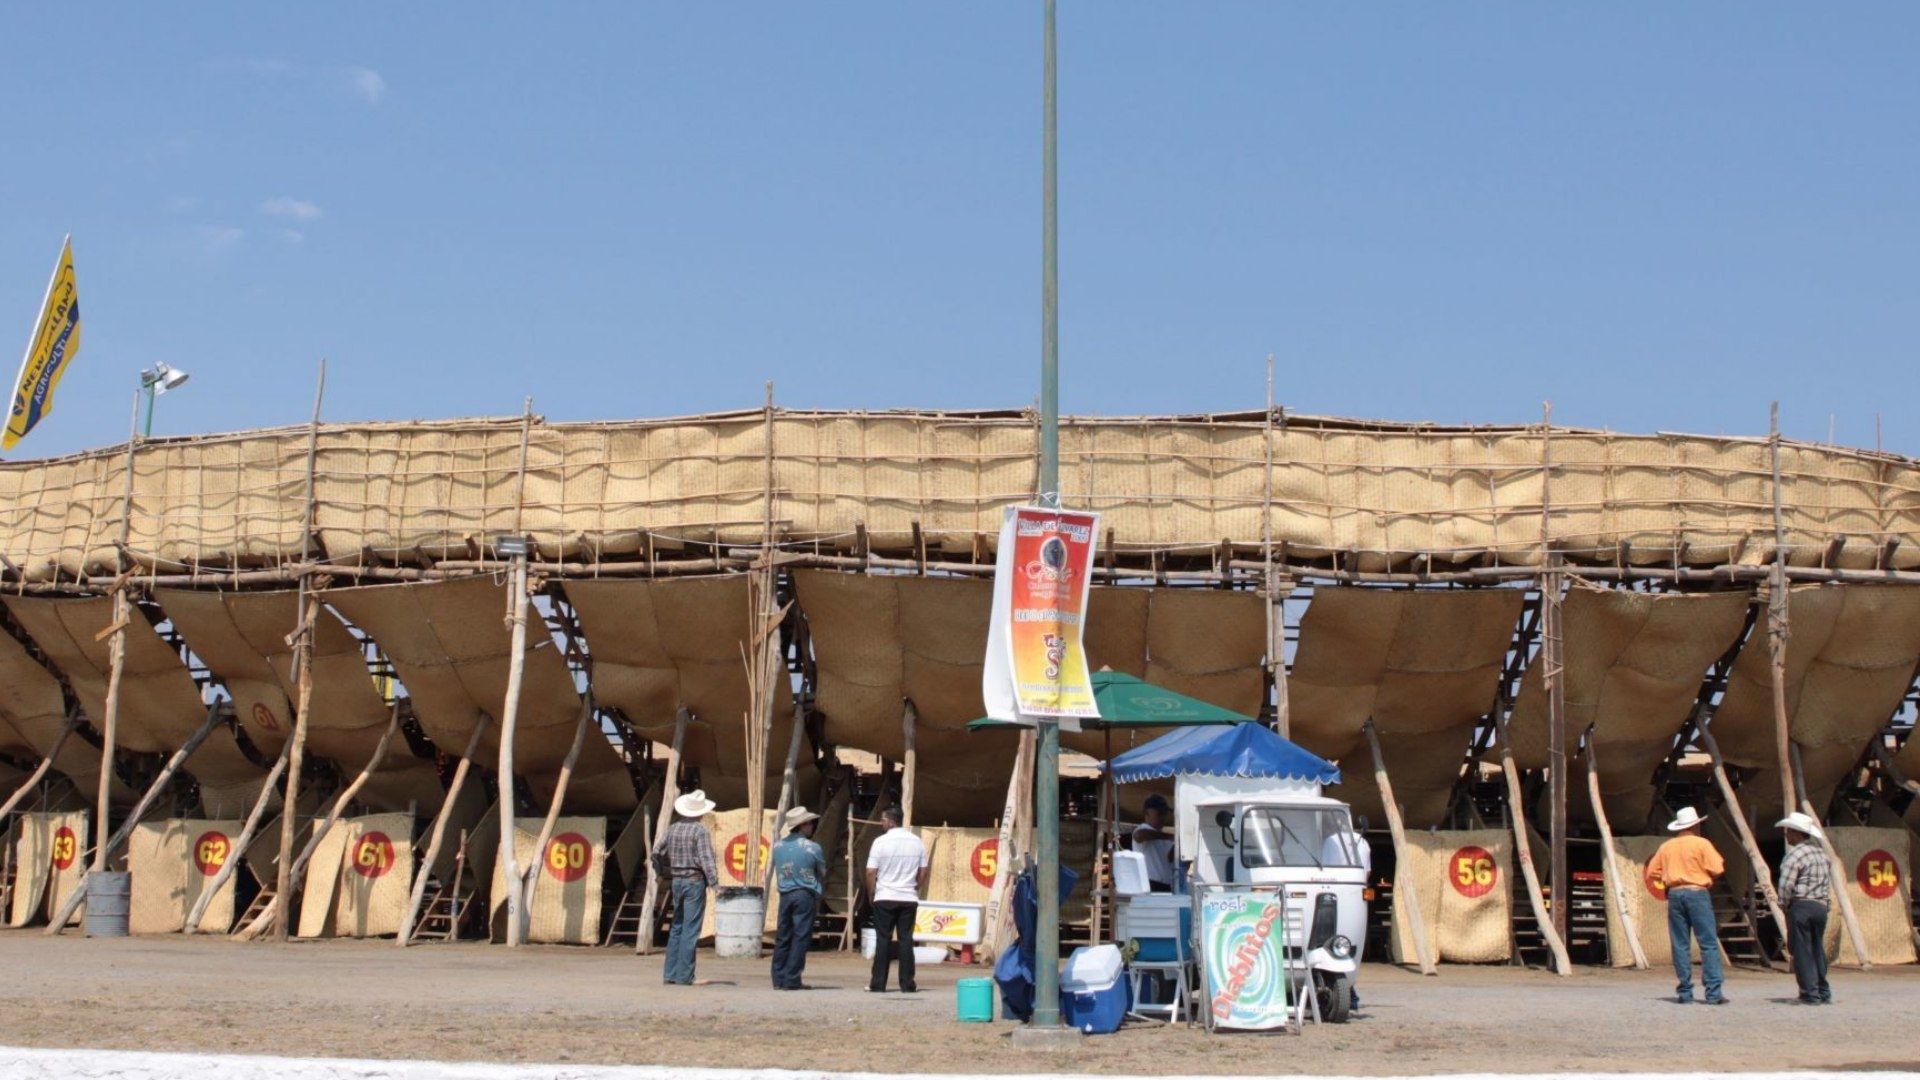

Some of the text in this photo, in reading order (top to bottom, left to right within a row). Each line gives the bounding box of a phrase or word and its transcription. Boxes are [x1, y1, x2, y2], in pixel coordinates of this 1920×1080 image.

[23, 355, 44, 391] NEW
[54, 836, 73, 860] 63
[199, 840, 226, 866] 62
[358, 842, 385, 868] 61
[550, 842, 584, 870] 60
[979, 850, 996, 877] 5
[1458, 857, 1492, 886] 56
[1868, 860, 1897, 887] 54
[1211, 902, 1281, 1020] Diablitos
